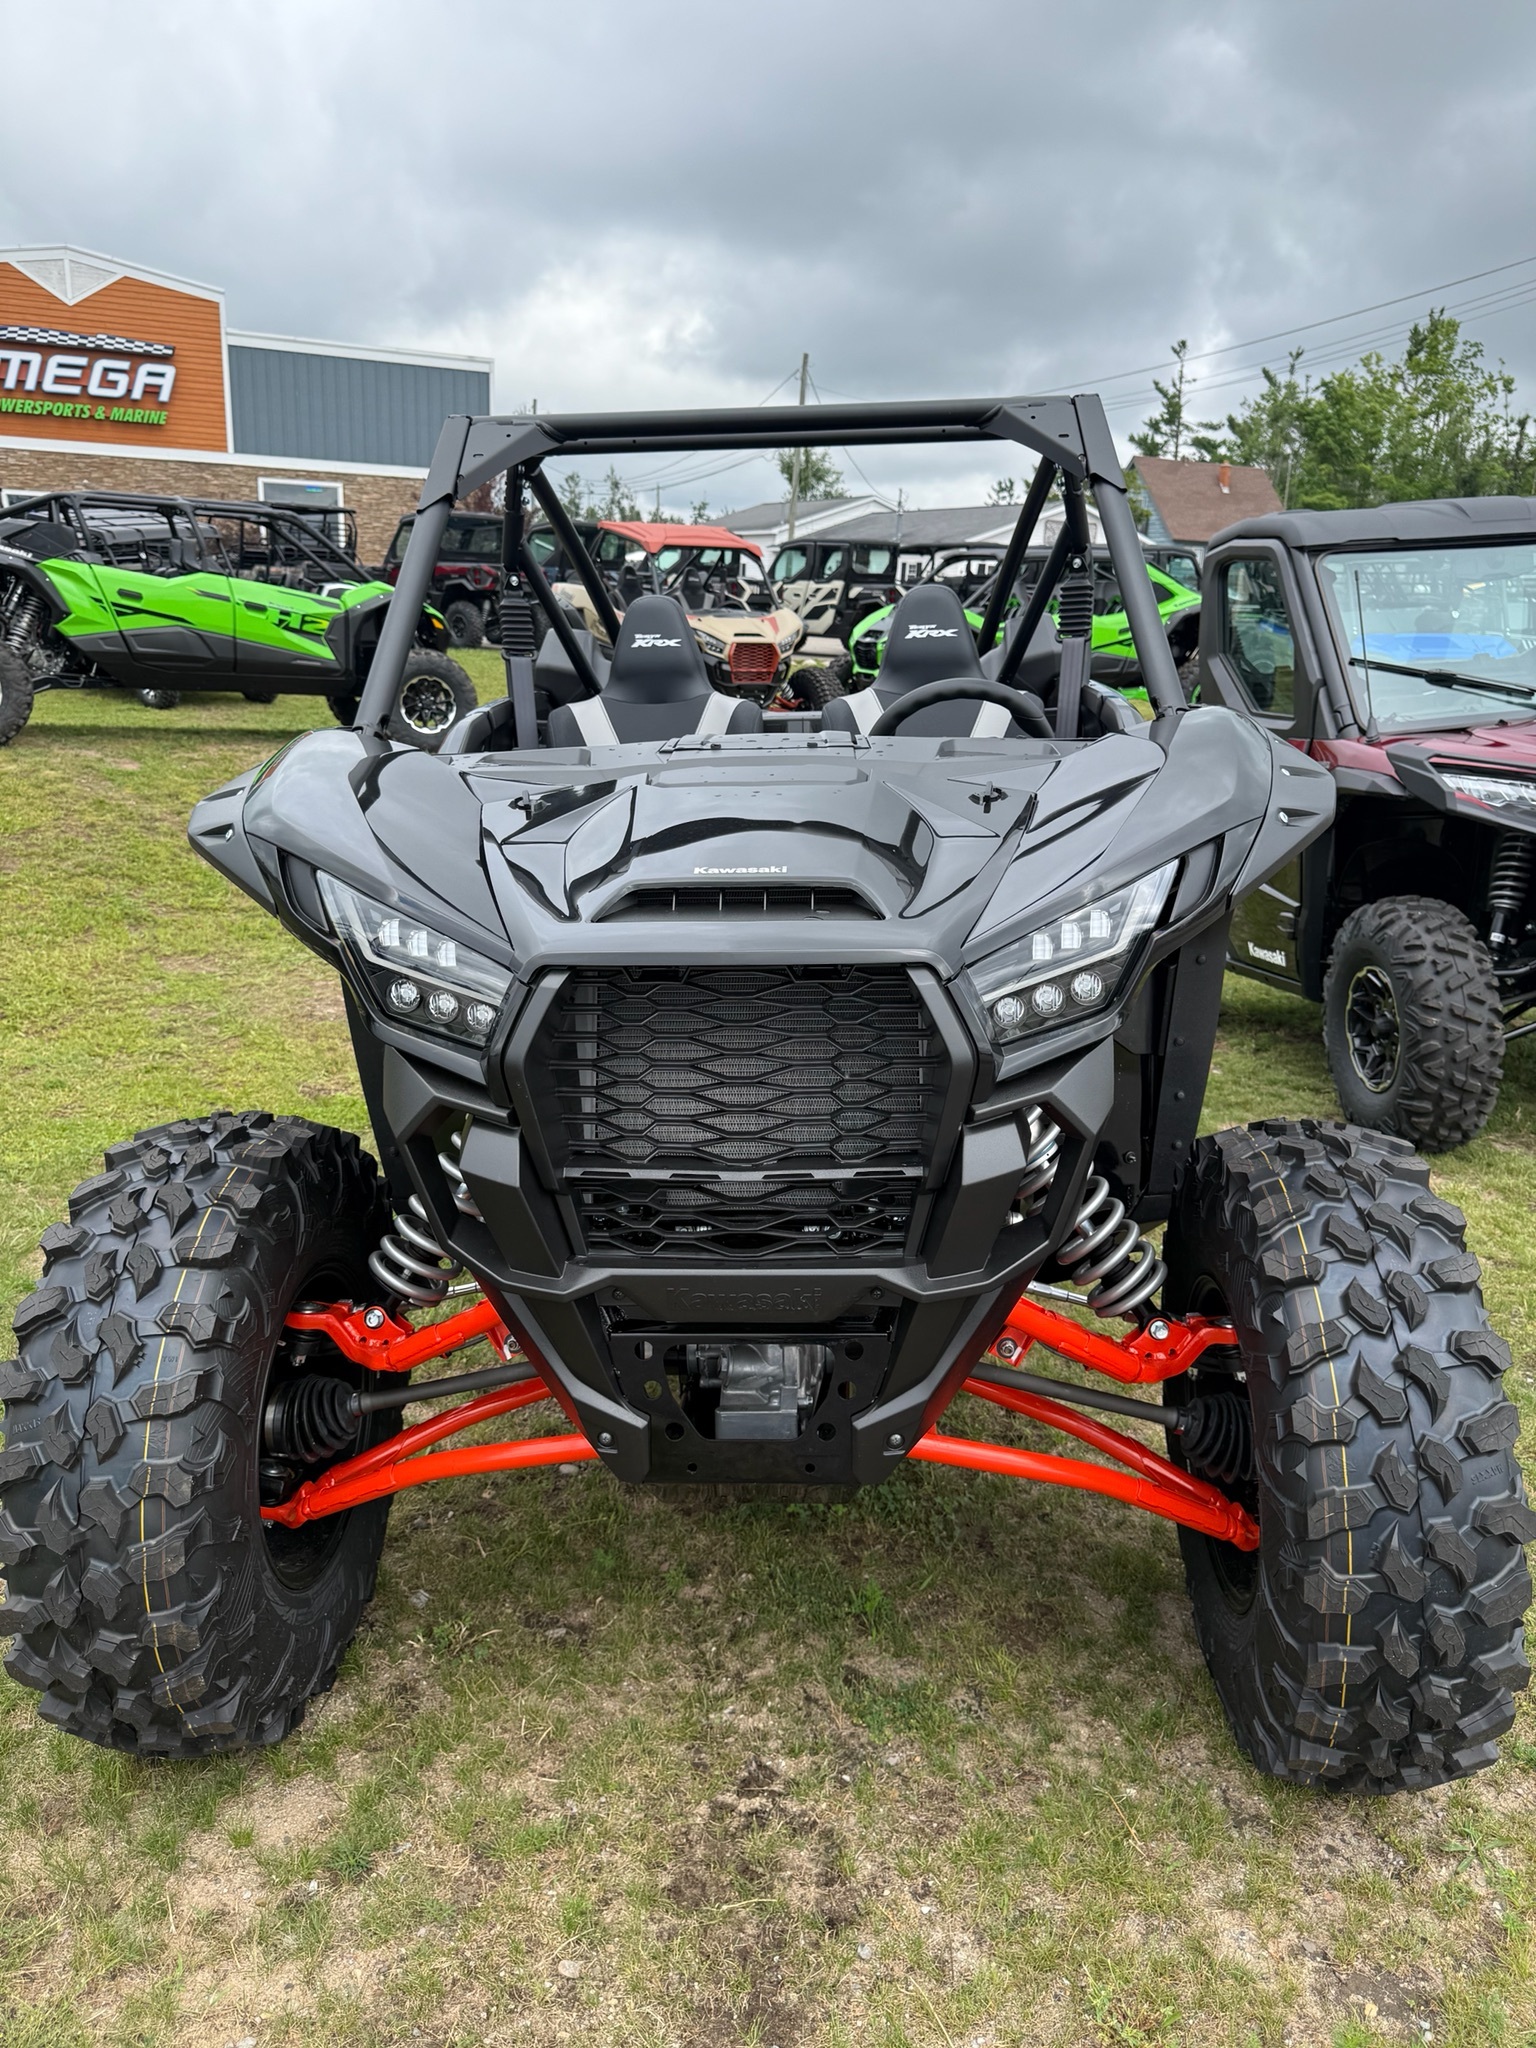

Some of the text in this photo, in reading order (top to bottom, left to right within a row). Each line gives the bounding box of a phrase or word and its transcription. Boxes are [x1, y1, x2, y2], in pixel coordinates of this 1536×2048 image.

[0, 397, 169, 425] WERSPORTS & MARINE
[630, 638, 682, 648] KRX
[904, 628, 959, 640] KRX
[693, 865, 788, 875] Kawasaki
[1247, 941, 1287, 967] Kawasaki
[666, 1287, 822, 1312] Kawasaki
